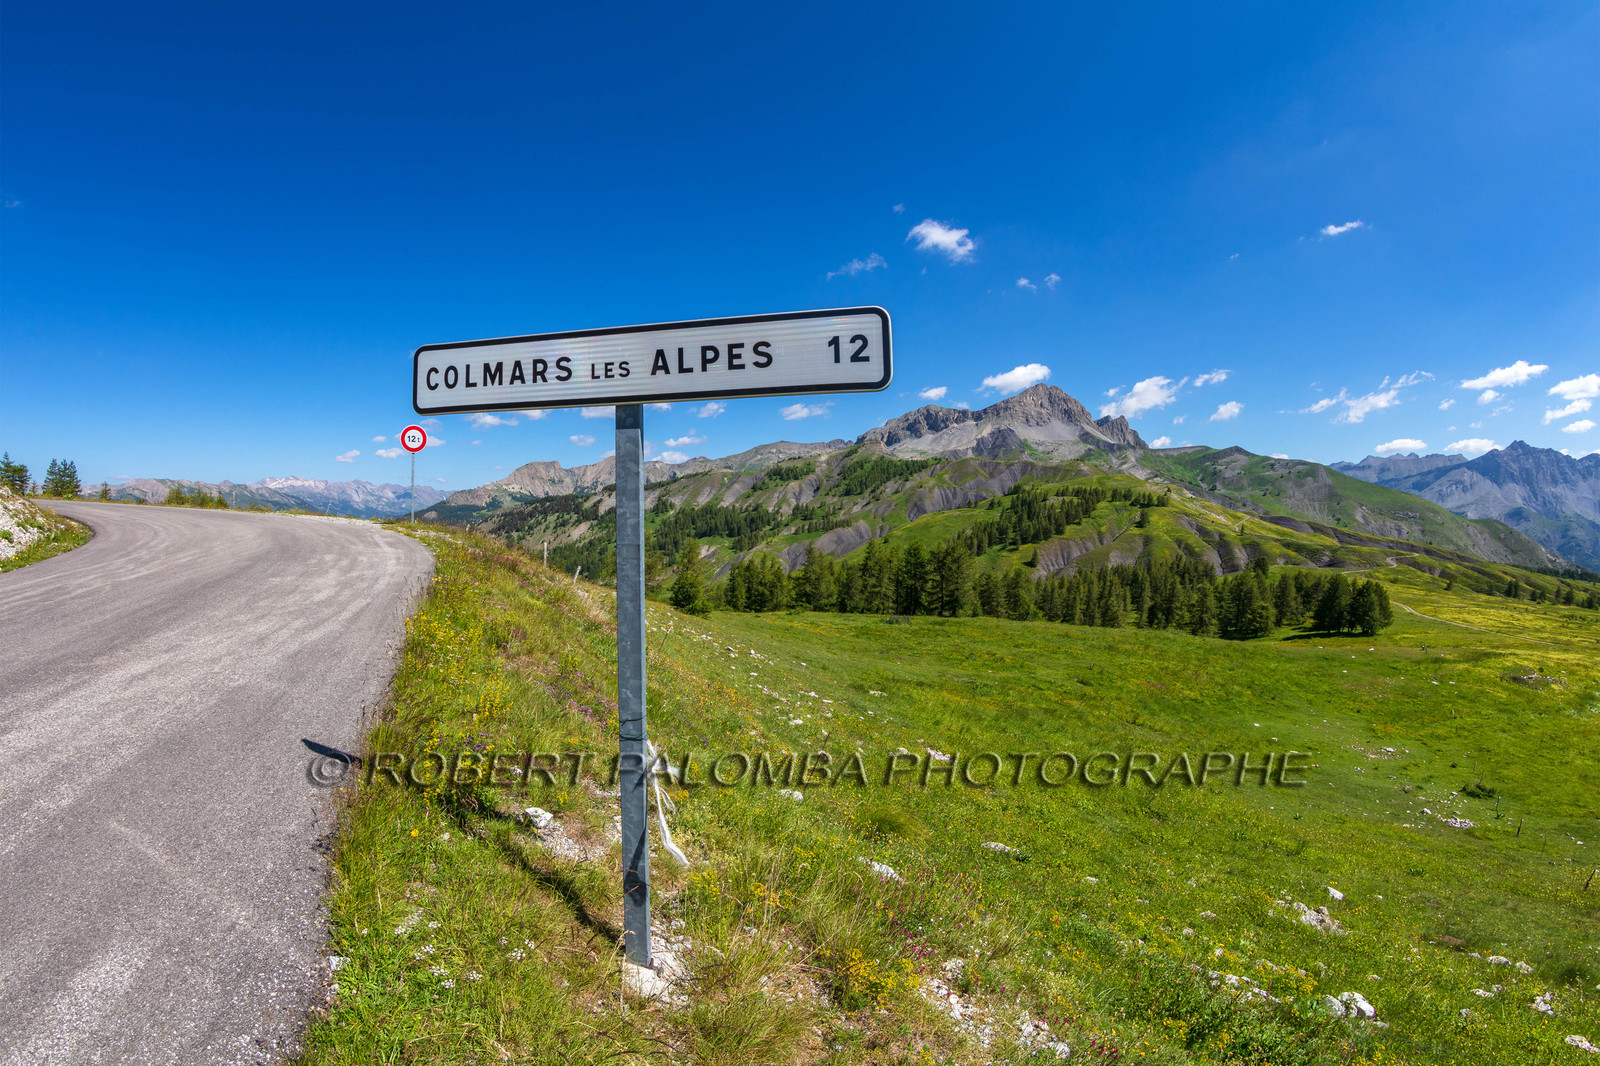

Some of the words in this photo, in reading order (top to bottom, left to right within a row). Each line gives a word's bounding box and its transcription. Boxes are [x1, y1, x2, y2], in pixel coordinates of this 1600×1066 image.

[426, 356, 573, 391] COLMARS
[591, 361, 631, 380] LES
[650, 341, 773, 376] ALPES
[827, 334, 870, 364] 12
